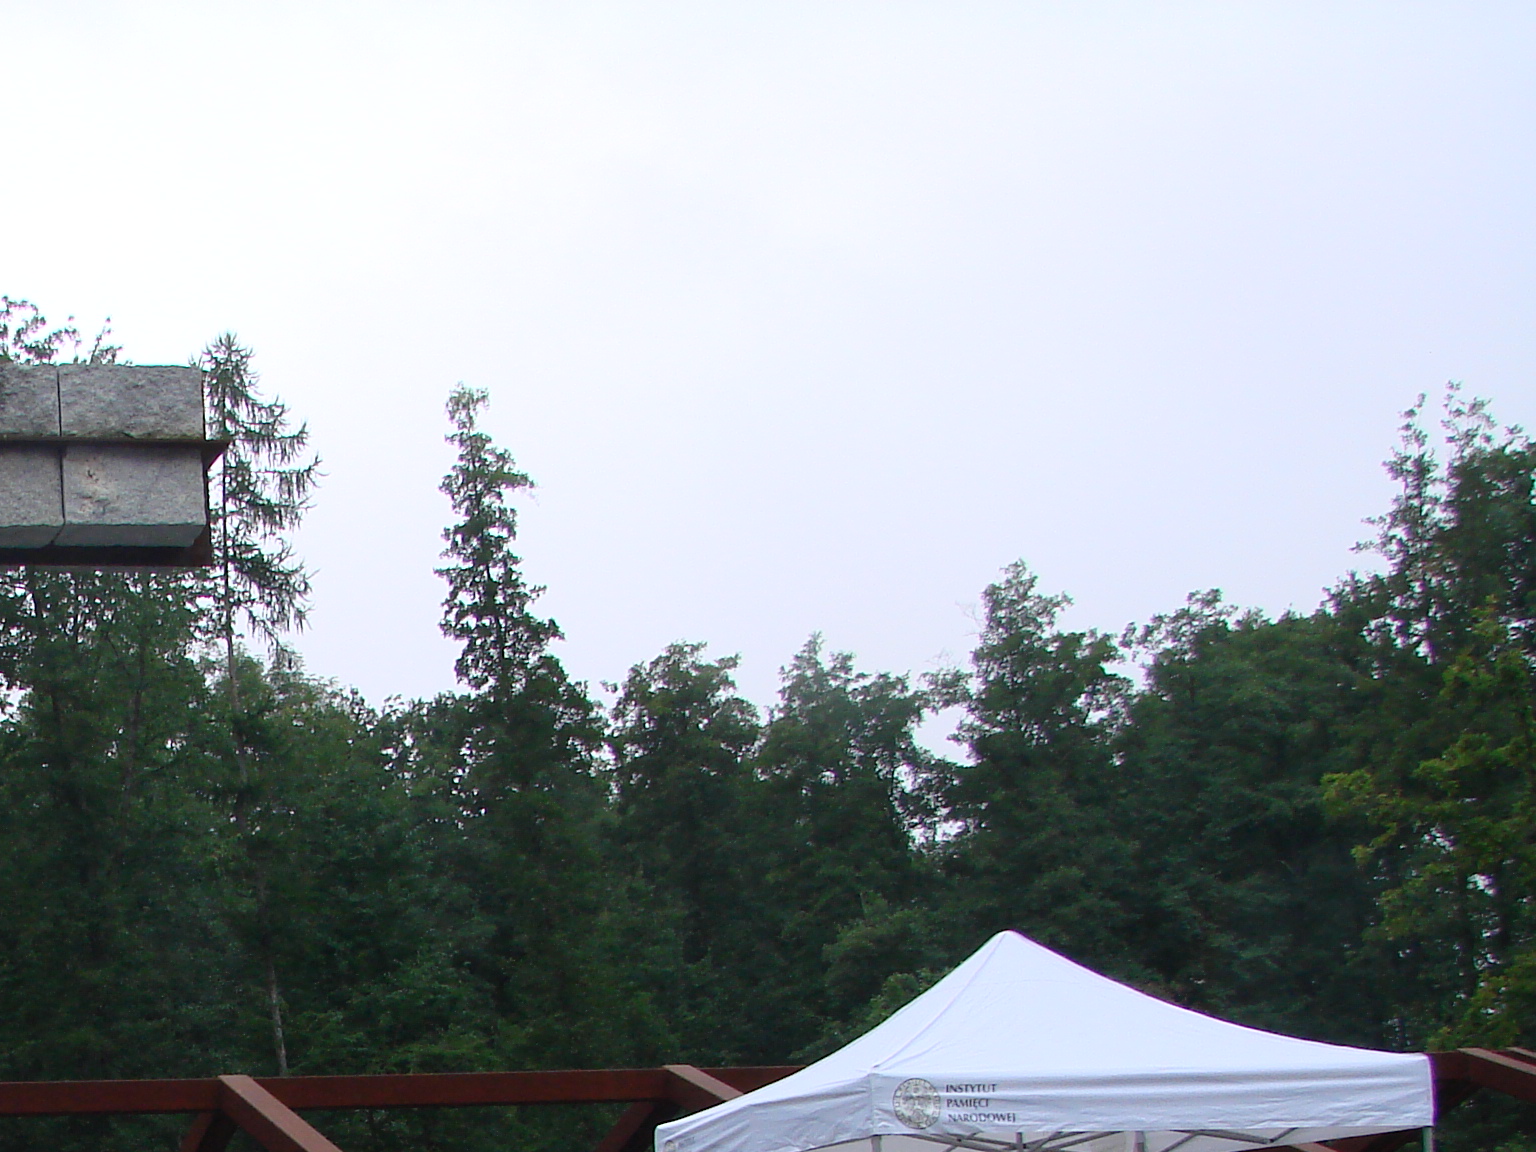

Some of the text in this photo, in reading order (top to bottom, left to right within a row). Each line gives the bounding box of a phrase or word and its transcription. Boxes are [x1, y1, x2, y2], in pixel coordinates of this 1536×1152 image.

[946, 1084, 997, 1093] INSTYTUT
[946, 1098, 990, 1110] PAMIĘCI
[948, 1113, 1017, 1123] NARODOWEJ
